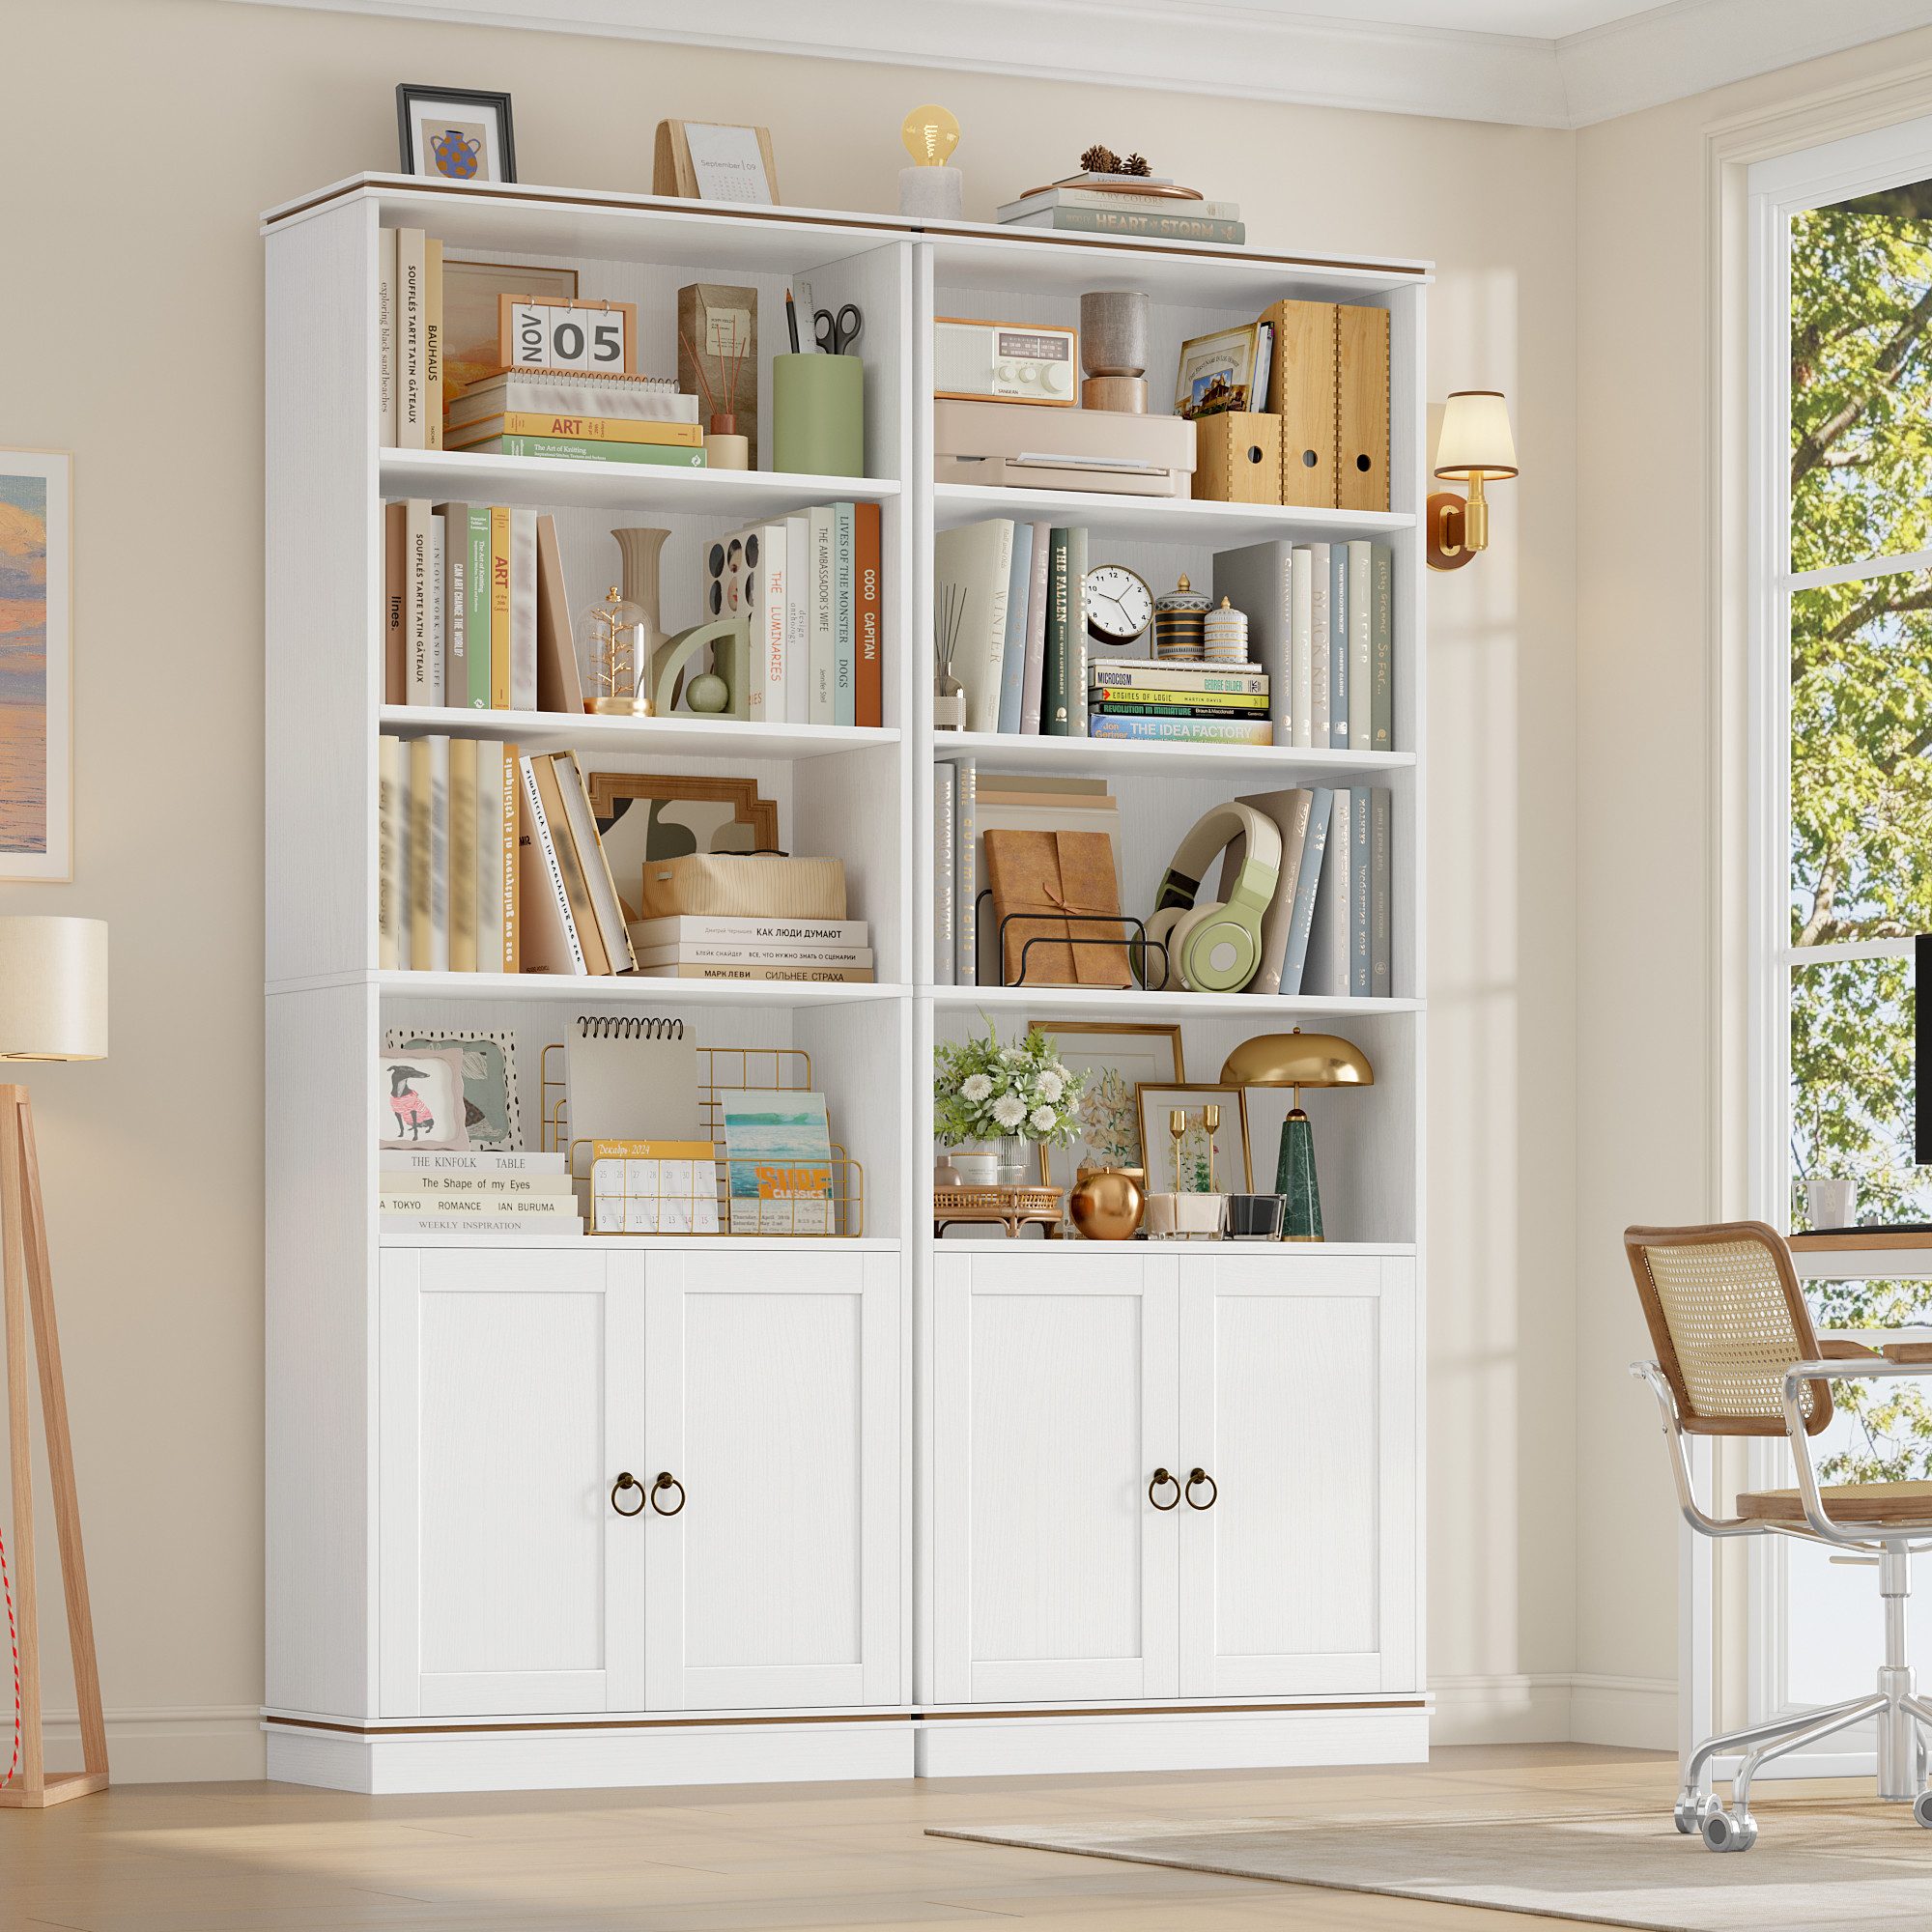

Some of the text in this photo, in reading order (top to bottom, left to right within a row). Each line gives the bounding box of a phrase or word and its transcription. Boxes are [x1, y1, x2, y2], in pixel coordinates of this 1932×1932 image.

[700, 159, 740, 169] September
[1095, 213, 1149, 232] HEART
[1160, 219, 1214, 238] STORM
[380, 282, 390, 413] exploring black sand beaches
[408, 265, 418, 424] SOUFFLÉS TARTE TATIN GÂTEAUX
[522, 313, 542, 362] NOV
[428, 325, 438, 382] BAUHAUS
[552, 418, 582, 435] ART
[564, 446, 587, 455] Knitting
[495, 556, 508, 589] ART
[819, 527, 829, 632] THE AMBASSADOR'S WIFE
[1055, 546, 1067, 623] THE FALLEN
[1378, 560, 1388, 590] Kelsey
[391, 596, 401, 631] lines.
[416, 533, 426, 683] SOUFFLÉS TARTE TATIN GÂTEAUX
[454, 564, 464, 657] CAN ART CHANGE THE WORLD?
[838, 516, 849, 688] LIVES OF THE MONSTER DOGS
[864, 569, 875, 660] COCO CAPITAN
[1379, 593, 1388, 635] Grammer
[770, 571, 782, 682] THE LUMINARIES
[788, 602, 796, 645] anthology
[797, 610, 806, 639] design
[990, 590, 1007, 664] WINTER
[1377, 643, 1388, 658] So
[1097, 672, 1243, 692] MICROCOSM GEORGE GILDER
[1154, 694, 1172, 702] LOGIC
[1094, 730, 1128, 739] Gertner
[1102, 723, 1119, 731] Jon
[1130, 723, 1254, 739] THE IDEA FACTORY
[756, 928, 773, 937] КАК
[775, 928, 803, 939] ЛЮДИ
[804, 929, 842, 940] ДУМАЮТ
[704, 970, 844, 981] МАРК ЛЕВИ СИЛЬНЕЕ СТРАХА
[411, 1156, 526, 1169] THE KINFOLK TABLE
[631, 1145, 650, 1155] 2024
[422, 1178, 531, 1192] The Shape of my Eyes
[773, 1189, 825, 1199] CLASSICS
[393, 1201, 421, 1210] TOKYO
[438, 1201, 482, 1210] ROMANCE
[498, 1202, 513, 1211] IAN
[518, 1202, 555, 1212] BURUMA
[418, 1221, 522, 1230] WEEKLY INSPIRATION
